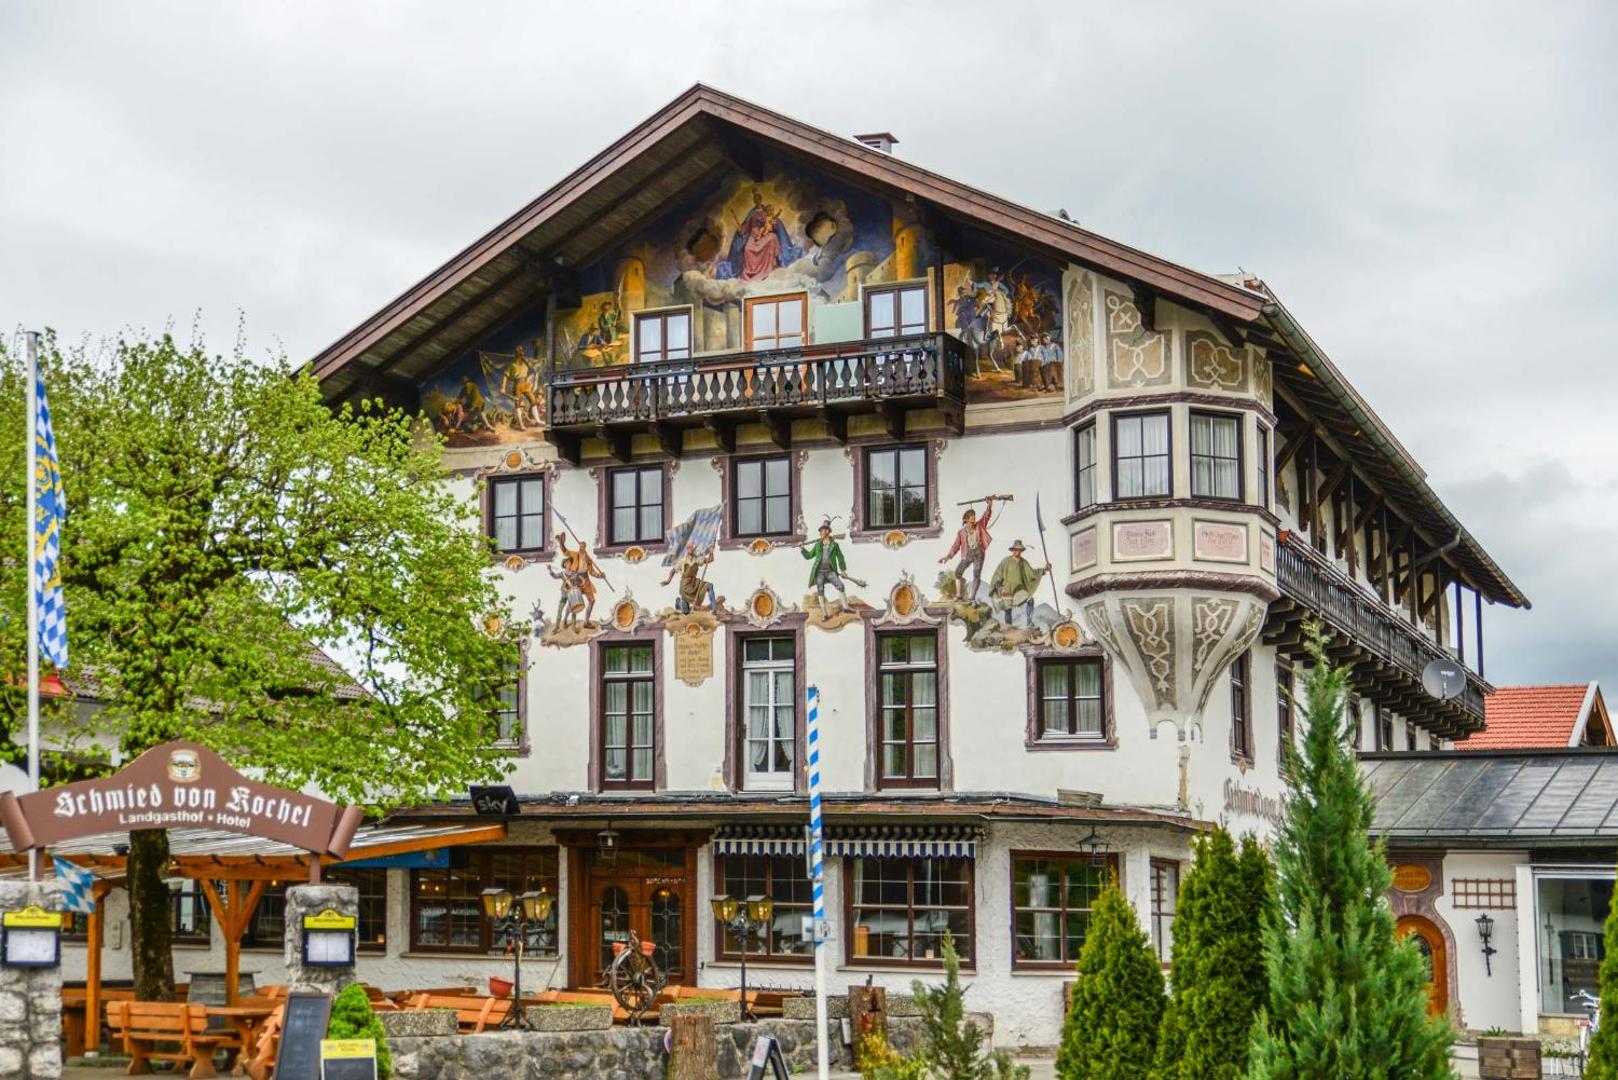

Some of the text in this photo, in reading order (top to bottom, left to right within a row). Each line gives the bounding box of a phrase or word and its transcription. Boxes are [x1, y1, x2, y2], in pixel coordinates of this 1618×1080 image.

[53, 783, 313, 828] Schmied von Kochel
[477, 795, 510, 814] sky
[118, 810, 251, 829] Landgasthof Hotel
